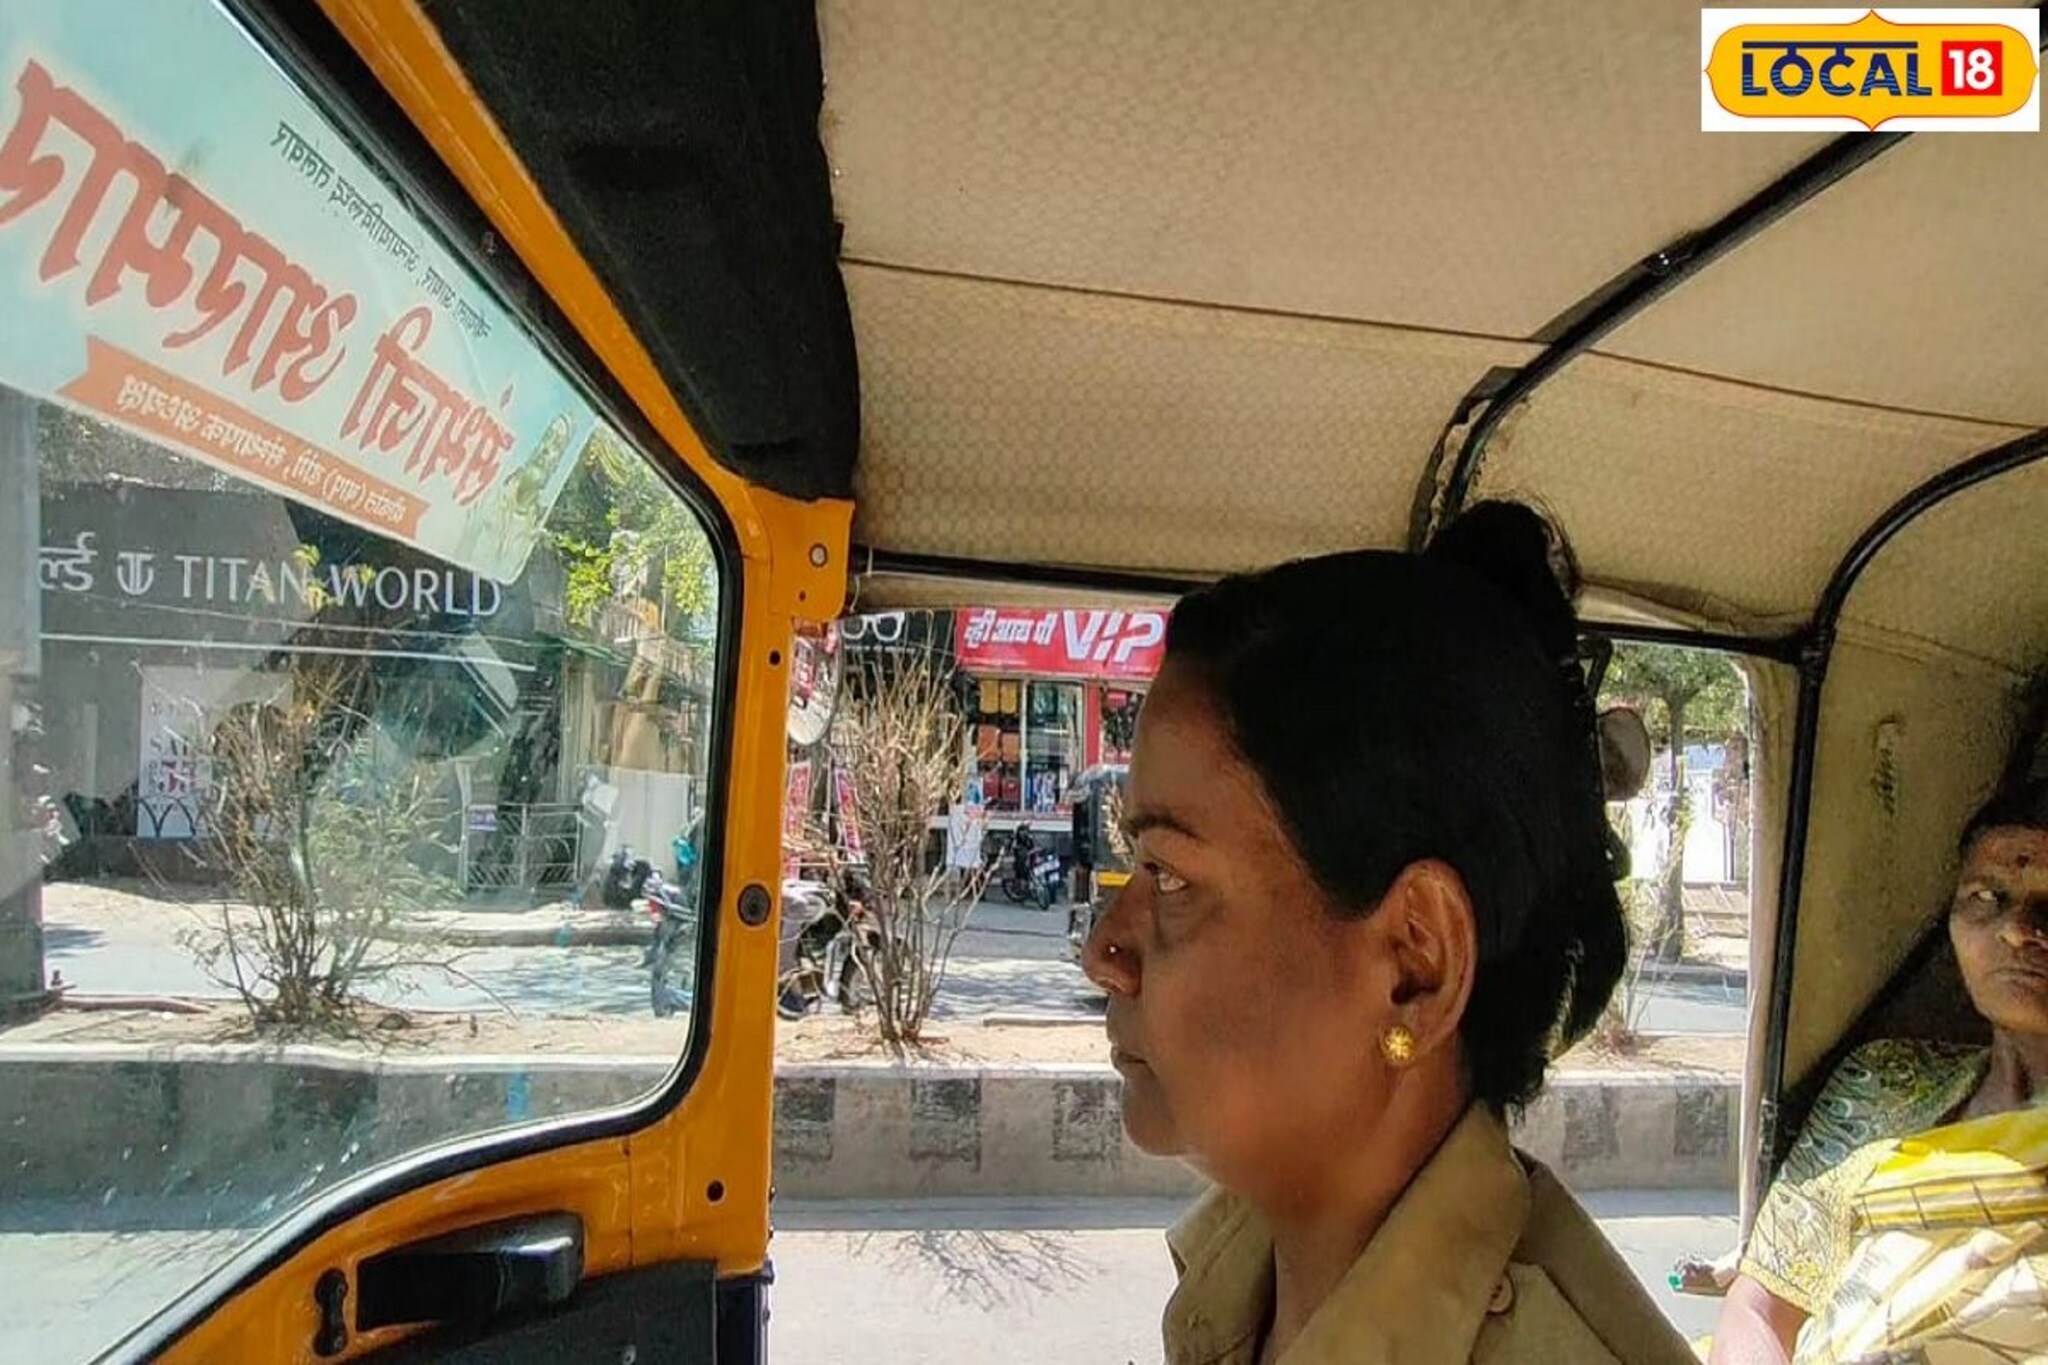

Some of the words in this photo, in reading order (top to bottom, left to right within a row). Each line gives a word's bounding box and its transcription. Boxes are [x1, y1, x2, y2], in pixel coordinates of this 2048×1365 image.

[174, 554, 310, 605] TITAN
[330, 562, 501, 616] WORLD
[1063, 609, 1165, 663] VIP
